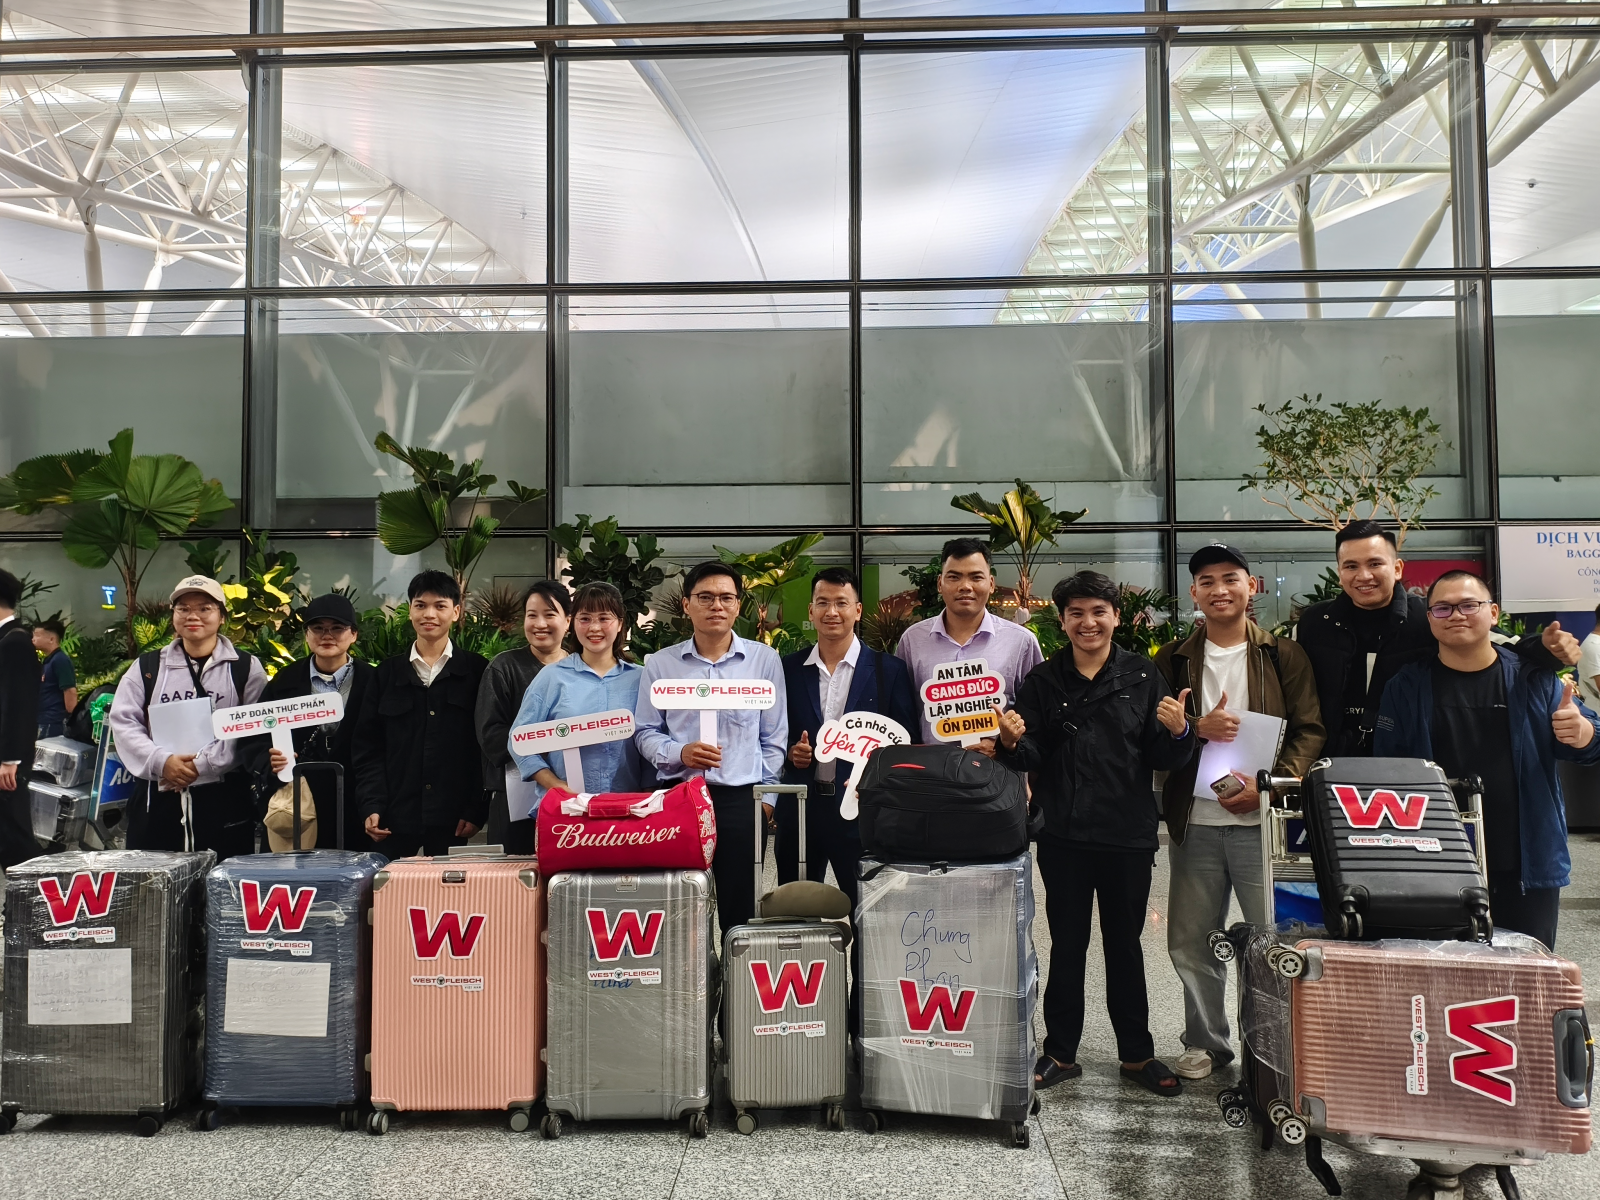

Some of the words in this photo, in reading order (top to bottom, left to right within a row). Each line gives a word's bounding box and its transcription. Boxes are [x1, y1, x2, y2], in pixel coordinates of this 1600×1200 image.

[1536, 532, 1578, 547] DỊCH
[1578, 567, 1600, 576] CÔN
[938, 668, 954, 680] AN
[956, 663, 983, 677] TÂM
[931, 684, 965, 699] SANG
[967, 679, 994, 694] ĐỨC
[230, 711, 247, 721] TẬP
[249, 707, 274, 717] ĐOÀN
[276, 704, 298, 714] THỰC
[300, 698, 325, 709] PHẨM
[929, 703, 952, 718] LẬP
[955, 696, 1000, 713] NGHIỆP
[222, 720, 262, 732] WEST
[278, 709, 336, 724] FLEISCH
[514, 728, 554, 742] WEST
[570, 715, 630, 732] FLEISCH
[846, 718, 862, 729] Cả
[865, 720, 887, 734] nhà
[943, 717, 960, 733] ỔN
[962, 717, 993, 732] ĐỊNH
[822, 728, 855, 754] Yên
[1334, 787, 1426, 827] W
[552, 823, 681, 848] Budweiser
[40, 872, 116, 924] W
[242, 882, 314, 930] W
[410, 909, 484, 957] W
[588, 910, 663, 960] W
[751, 962, 825, 1011] W
[900, 980, 975, 1031] W
[1448, 999, 1516, 1102] W
